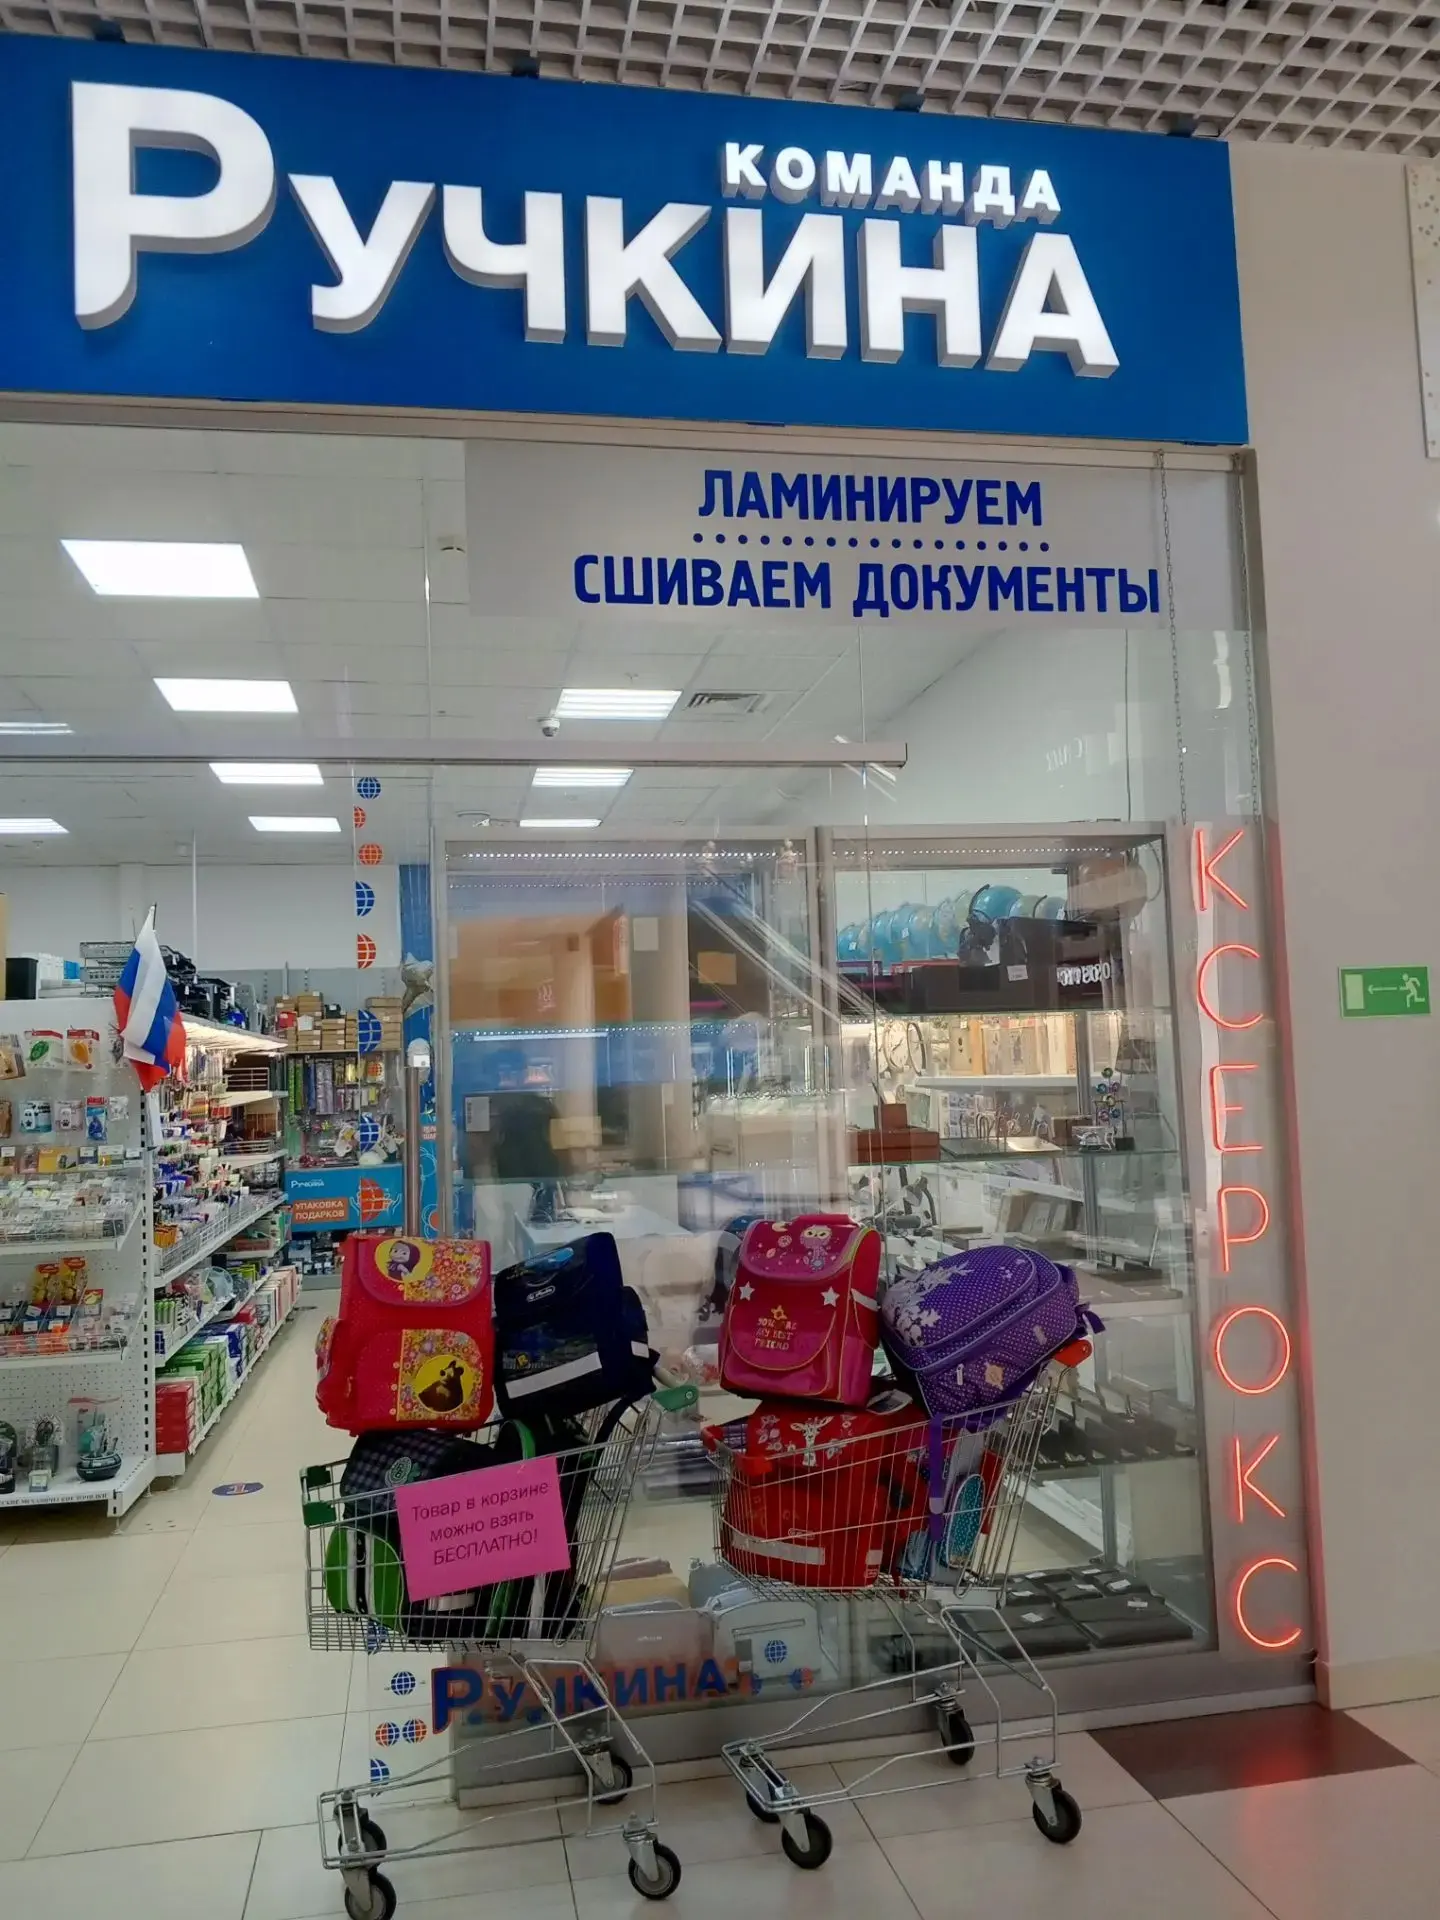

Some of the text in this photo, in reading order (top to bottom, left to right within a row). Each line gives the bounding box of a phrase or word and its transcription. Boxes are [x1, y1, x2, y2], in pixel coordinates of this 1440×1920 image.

[722, 142, 1061, 228] КОМАНДА
[698, 469, 1042, 526] ЛАМИНИРУЕМ
[574, 554, 1160, 618] СШИВАЕМ ДОКУМЕНТЫ
[295, 1200, 344, 1210] УПАКОВКА
[295, 1210, 345, 1221] ПОДАРКОВ
[1197, 829, 1303, 1649] КСЕРОКС
[411, 1482, 549, 1521] Товар в корзине
[429, 1510, 534, 1542] можно взять
[433, 1528, 538, 1566] БЕСПЛАТНО!
